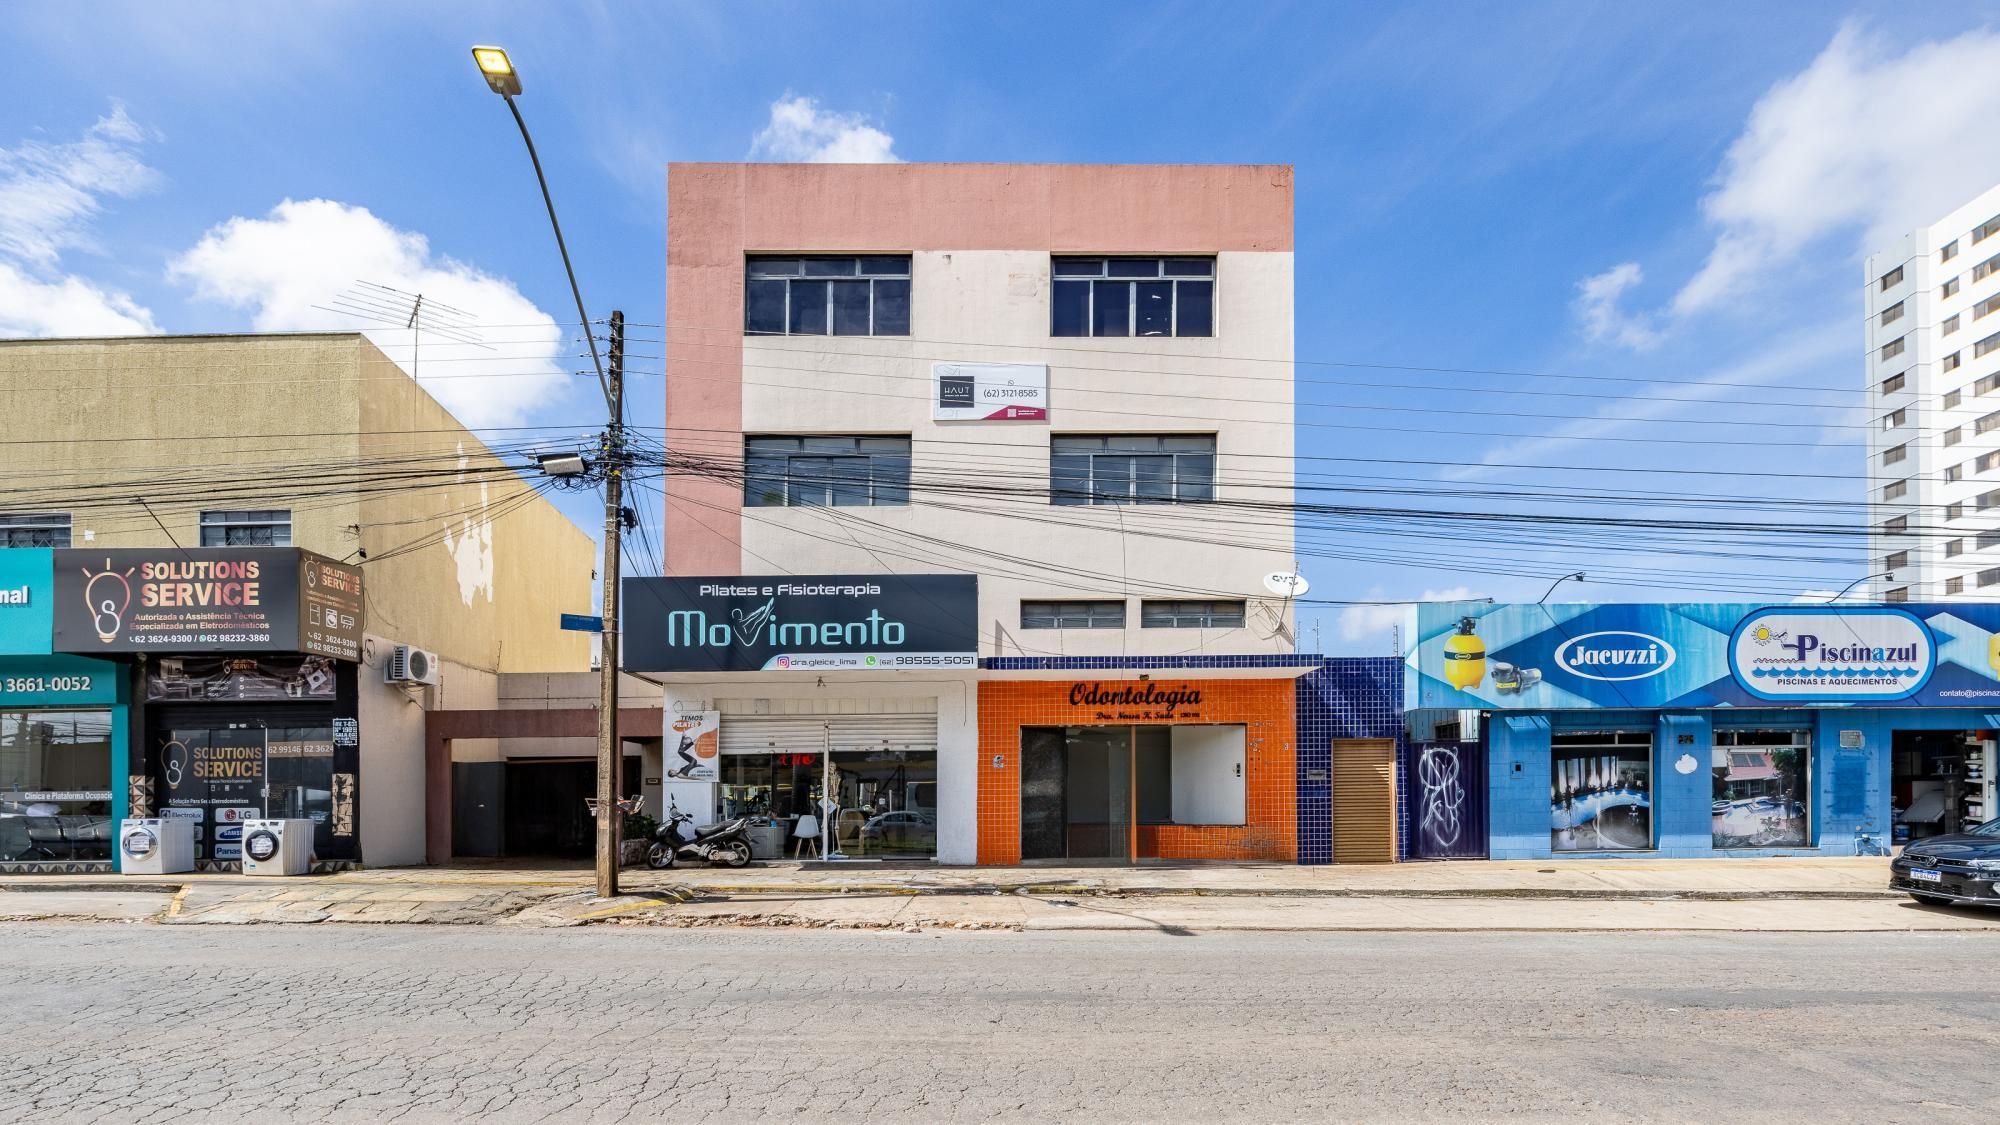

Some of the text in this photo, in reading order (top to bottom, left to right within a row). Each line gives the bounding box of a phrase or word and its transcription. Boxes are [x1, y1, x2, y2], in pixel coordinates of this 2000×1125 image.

[984, 389, 1000, 398] (62)
[140, 562, 260, 580] SOLUTIONS
[322, 566, 360, 584] SOLUTIONS
[322, 574, 360, 595] SERVICE
[700, 582, 881, 598] Pilates e Fisioterapia
[140, 582, 260, 606] SERVICE
[134, 612, 178, 621] Autorizada
[186, 612, 232, 620] Assistência
[234, 612, 265, 620] Técnica
[130, 622, 184, 632] Especializada
[200, 622, 270, 630] Eletrodomésticos
[134, 636, 146, 644] 62
[148, 634, 192, 643] 3624-9300
[206, 634, 218, 642] 62
[219, 634, 270, 642] 98232-3860
[314, 632, 357, 648] 62 3624-9300
[314, 642, 322, 651] 62
[1570, 644, 1658, 666] Jacuzzi
[1796, 634, 1918, 664] Piscinazul
[790, 658, 857, 667] dra.gleice_lima
[896, 656, 974, 665] 98555-5051
[6, 676, 91, 692] 3661-0052
[1069, 682, 1202, 712] Odontologia
[193, 747, 262, 760] SOLUTIONS
[192, 761, 262, 777] SERVICE
[24, 792, 46, 800] Clínica
[52, 792, 84, 800] Plataforma
[238, 810, 252, 820] LG
